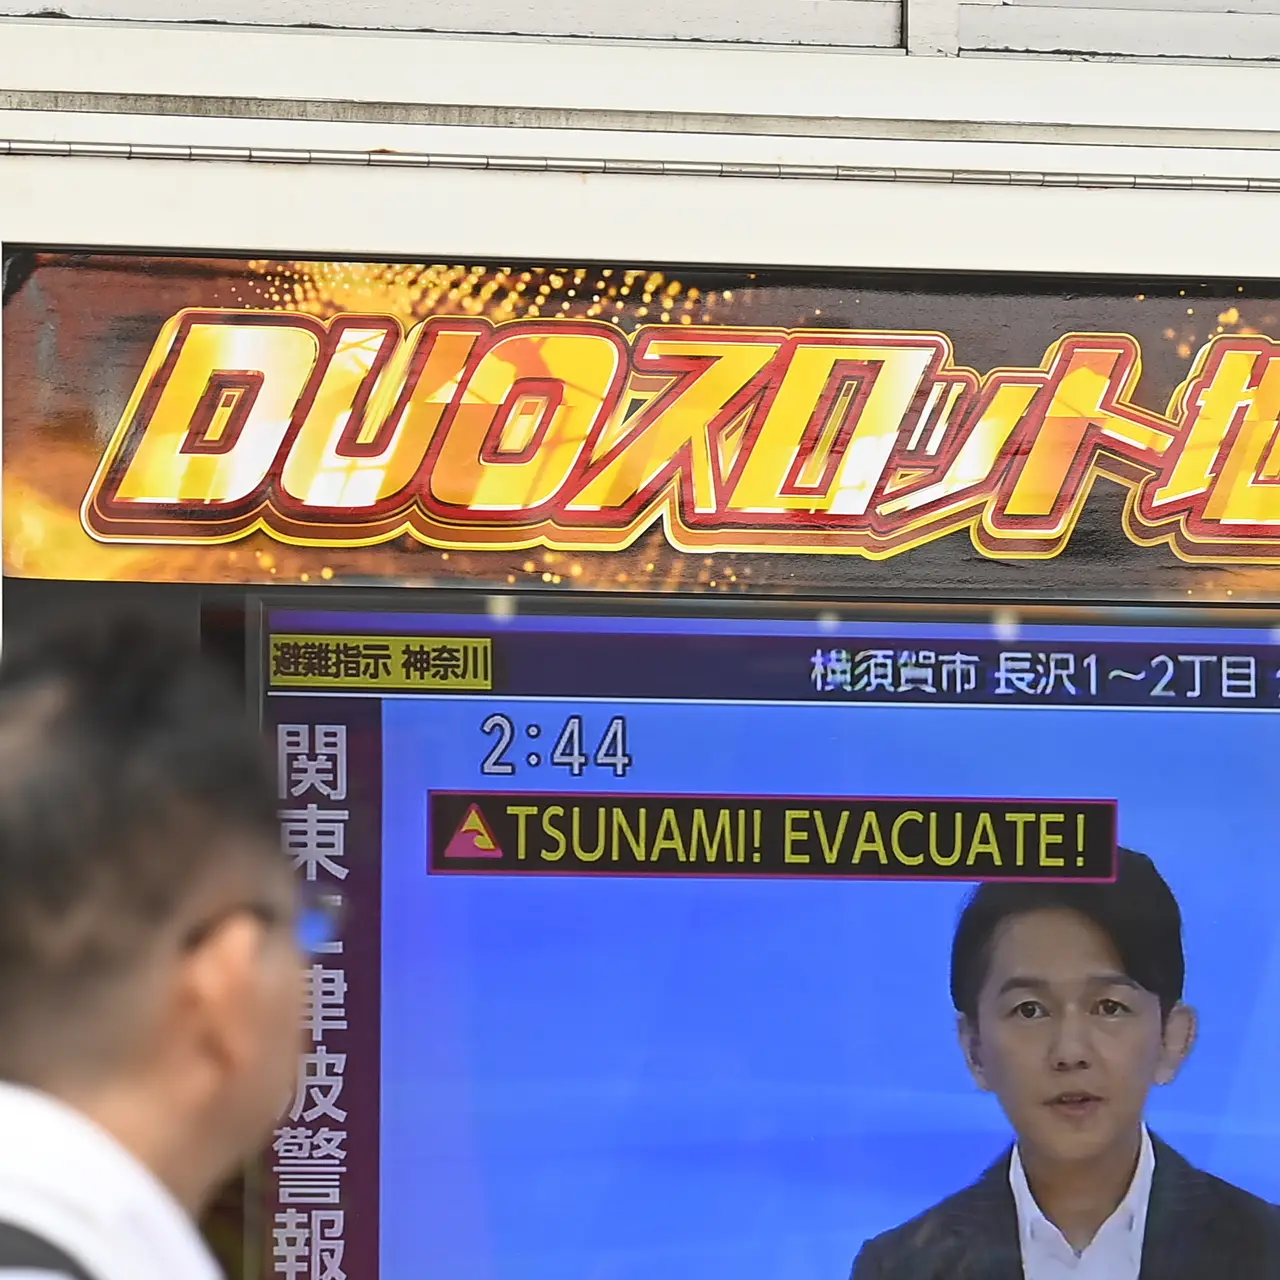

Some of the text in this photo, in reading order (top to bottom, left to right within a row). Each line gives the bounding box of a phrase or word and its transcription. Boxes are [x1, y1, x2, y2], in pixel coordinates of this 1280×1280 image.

[273, 642, 490, 681] 避難指示 神奈川
[810, 648, 980, 694] 横須賀市
[481, 713, 633, 777] 2:44
[506, 806, 1086, 867] TSUNAMI! EVACUATE!
